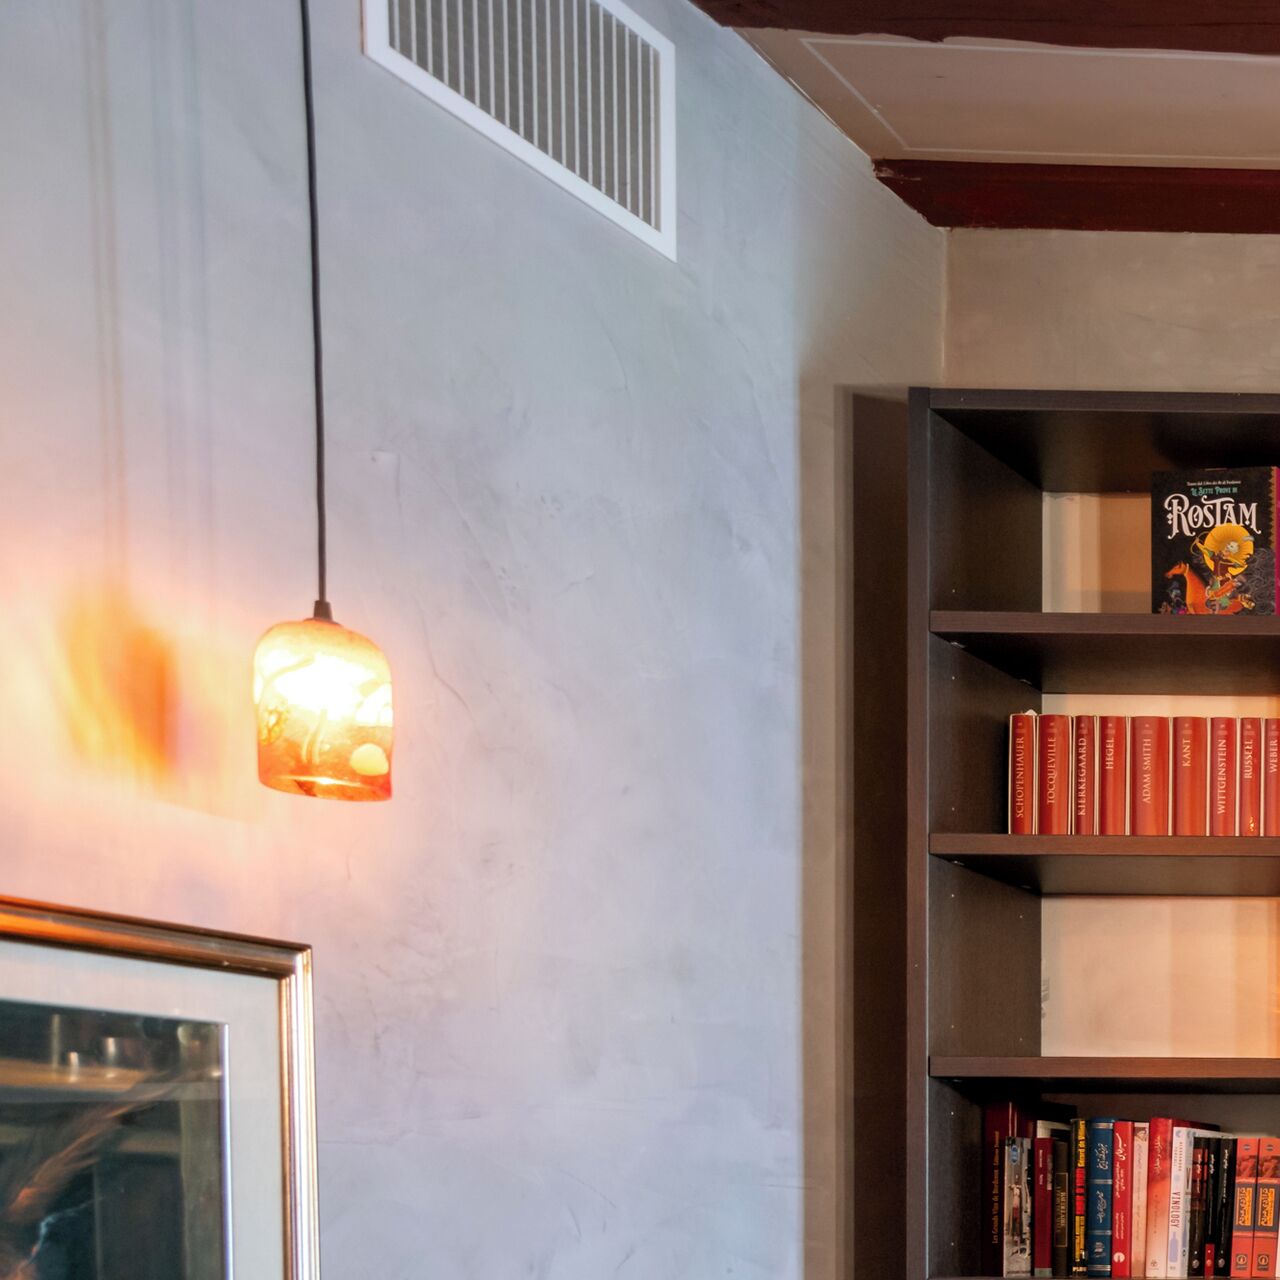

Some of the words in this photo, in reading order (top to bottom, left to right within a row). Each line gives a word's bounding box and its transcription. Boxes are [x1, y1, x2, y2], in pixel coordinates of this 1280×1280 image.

[1164, 493, 1261, 539] ROSTAM
[1047, 737, 1058, 805] TOCQUEVILLE
[1106, 738, 1115, 769] HEGEL
[1143, 738, 1152, 770] SMITH
[1182, 738, 1191, 767] KANT
[1243, 739, 1253, 779] RUSSELL
[1269, 739, 1278, 773] WEBER
[1016, 736, 1025, 818] SCHOPENHAUER
[1077, 737, 1087, 816] KIERKEGAARD
[1142, 773, 1152, 804] ADAM
[1217, 739, 1227, 814] WITTGENSTEIN
[1170, 1191, 1181, 1228] VINOLOGY
